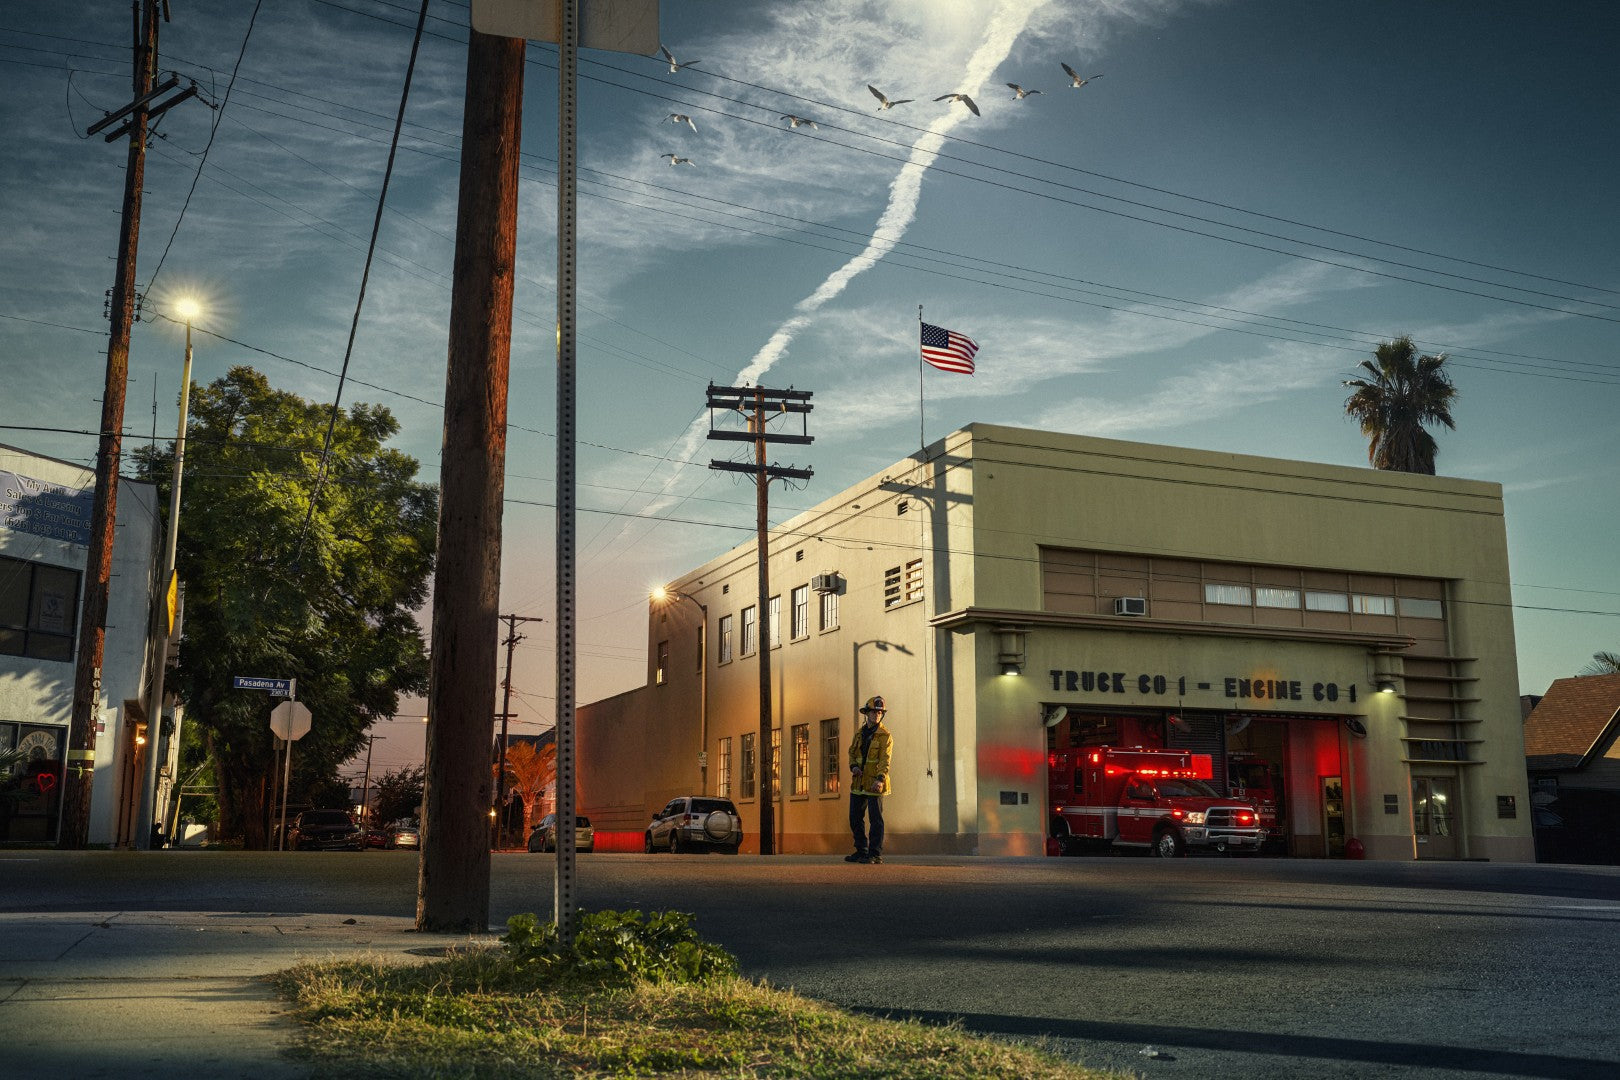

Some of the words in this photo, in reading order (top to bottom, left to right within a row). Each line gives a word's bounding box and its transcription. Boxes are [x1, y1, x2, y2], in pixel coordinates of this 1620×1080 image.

[43, 484, 66, 495] Auto
[6, 488, 32, 502] Sales
[35, 495, 42, 505] &
[45, 498, 81, 514] Leasing
[16, 504, 32, 517] Top
[45, 510, 60, 522] For
[61, 515, 80, 526] Your
[239, 679, 274, 688] Pasadena
[1050, 669, 1126, 694] TRUCK
[1138, 673, 1166, 695] CO
[1225, 678, 1302, 701] ENGINE
[1313, 682, 1339, 702] CO
[1179, 757, 1185, 768] 1
[1092, 771, 1097, 783] 1
